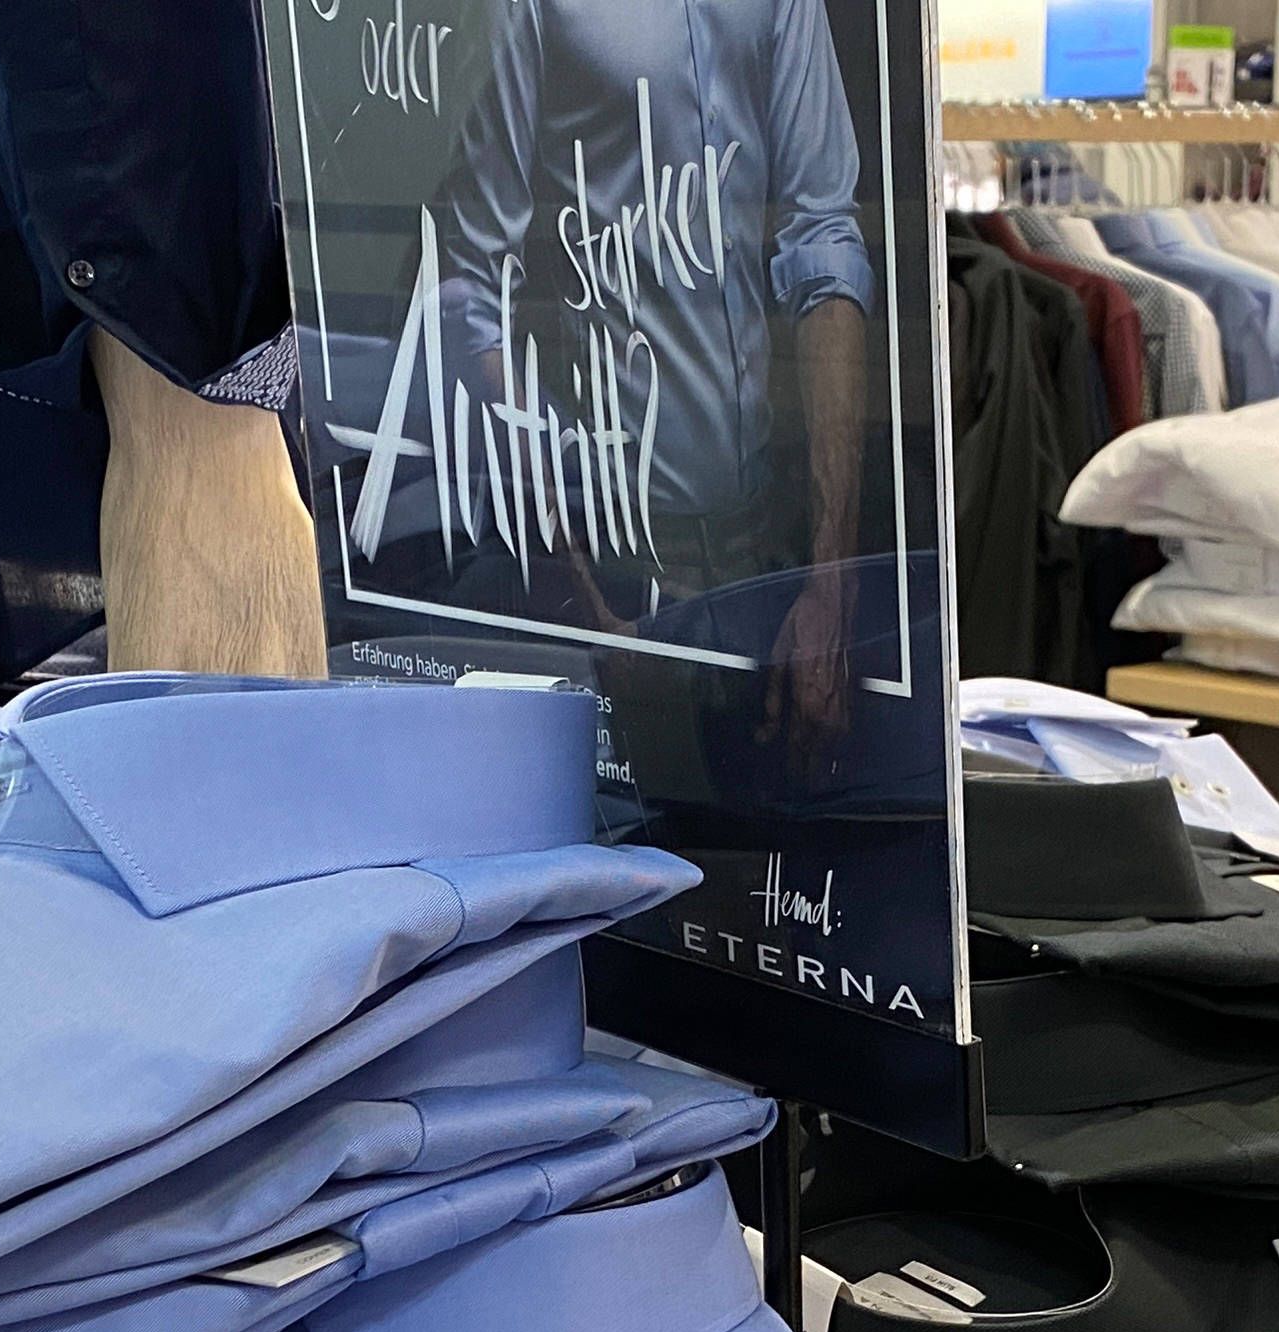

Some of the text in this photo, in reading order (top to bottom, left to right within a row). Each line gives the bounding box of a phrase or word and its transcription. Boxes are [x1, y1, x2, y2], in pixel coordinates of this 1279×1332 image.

[558, 78, 740, 325] starker
[352, 641, 413, 676] Erfahrung
[584, 687, 613, 713] as
[596, 727, 611, 746] in
[596, 760, 636, 784] emd.
[683, 921, 925, 1019] ETERNA
